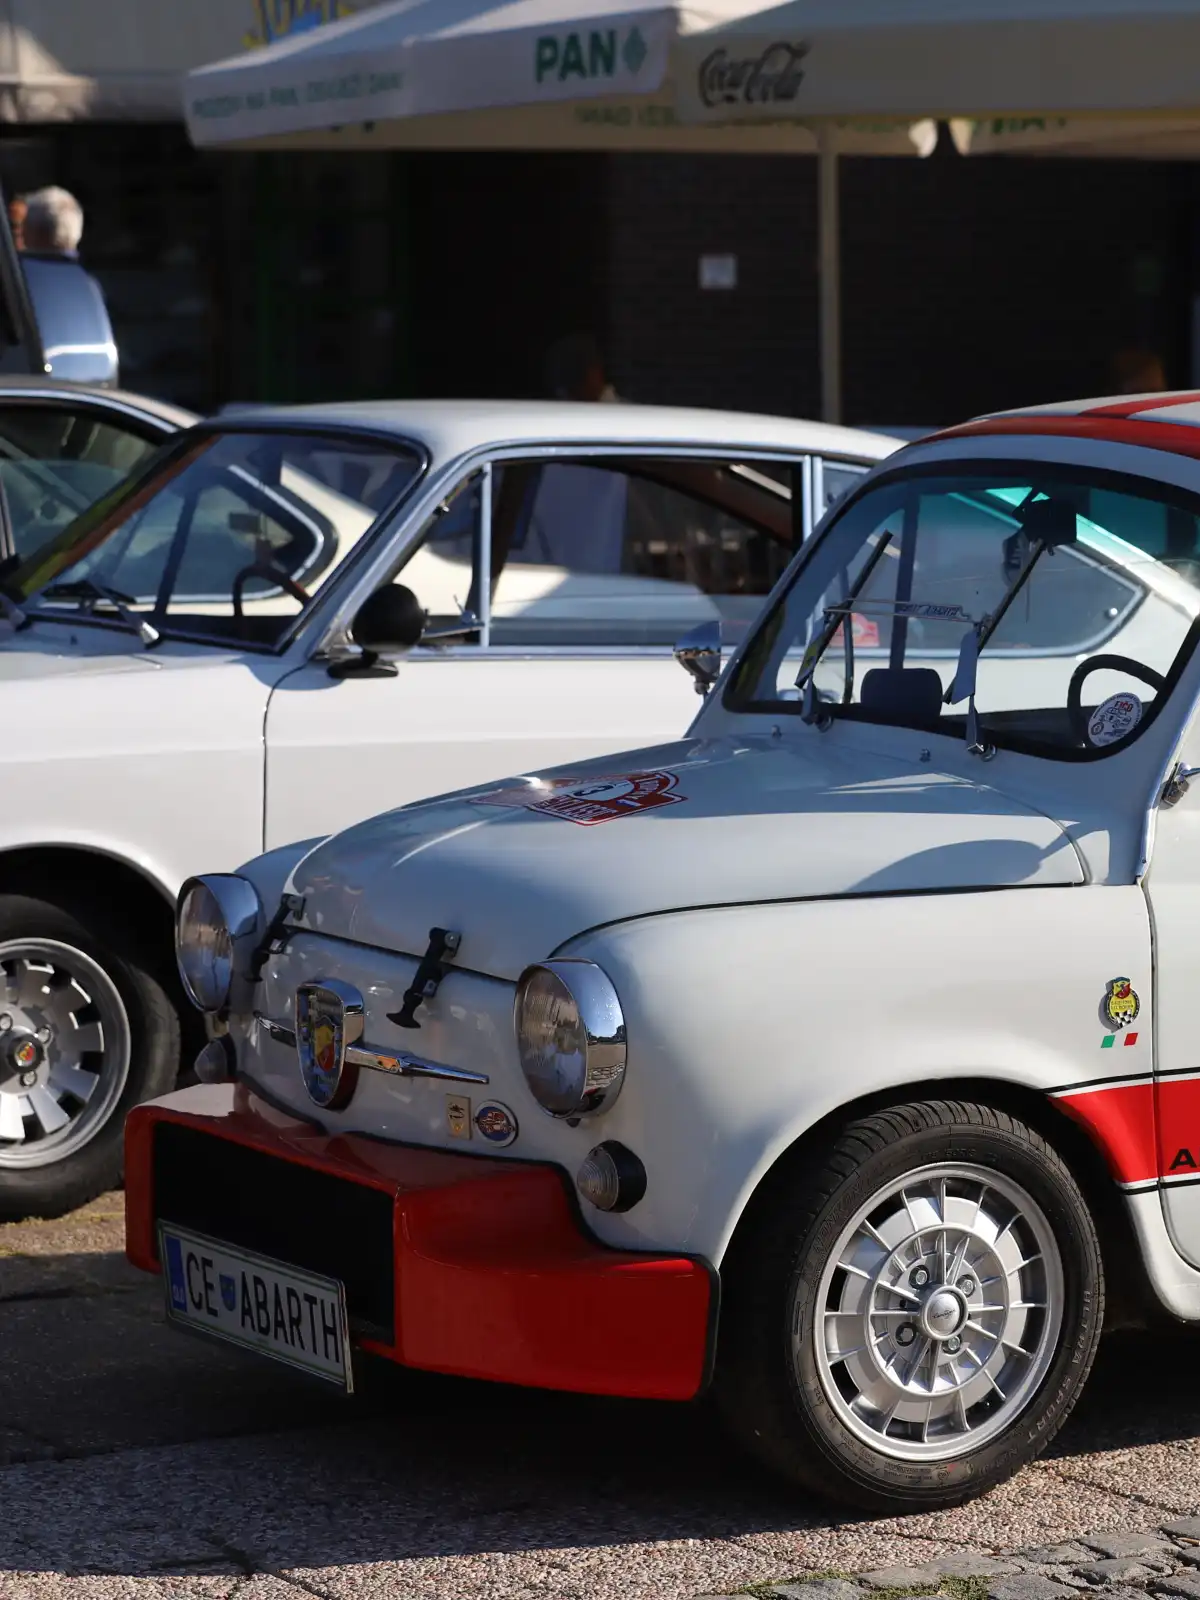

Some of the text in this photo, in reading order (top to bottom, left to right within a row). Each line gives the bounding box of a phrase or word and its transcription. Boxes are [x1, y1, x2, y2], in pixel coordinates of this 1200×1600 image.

[534, 30, 618, 84] PAN
[700, 41, 811, 106] Coca-Cola
[186, 1252, 340, 1363] CE ABARTH
